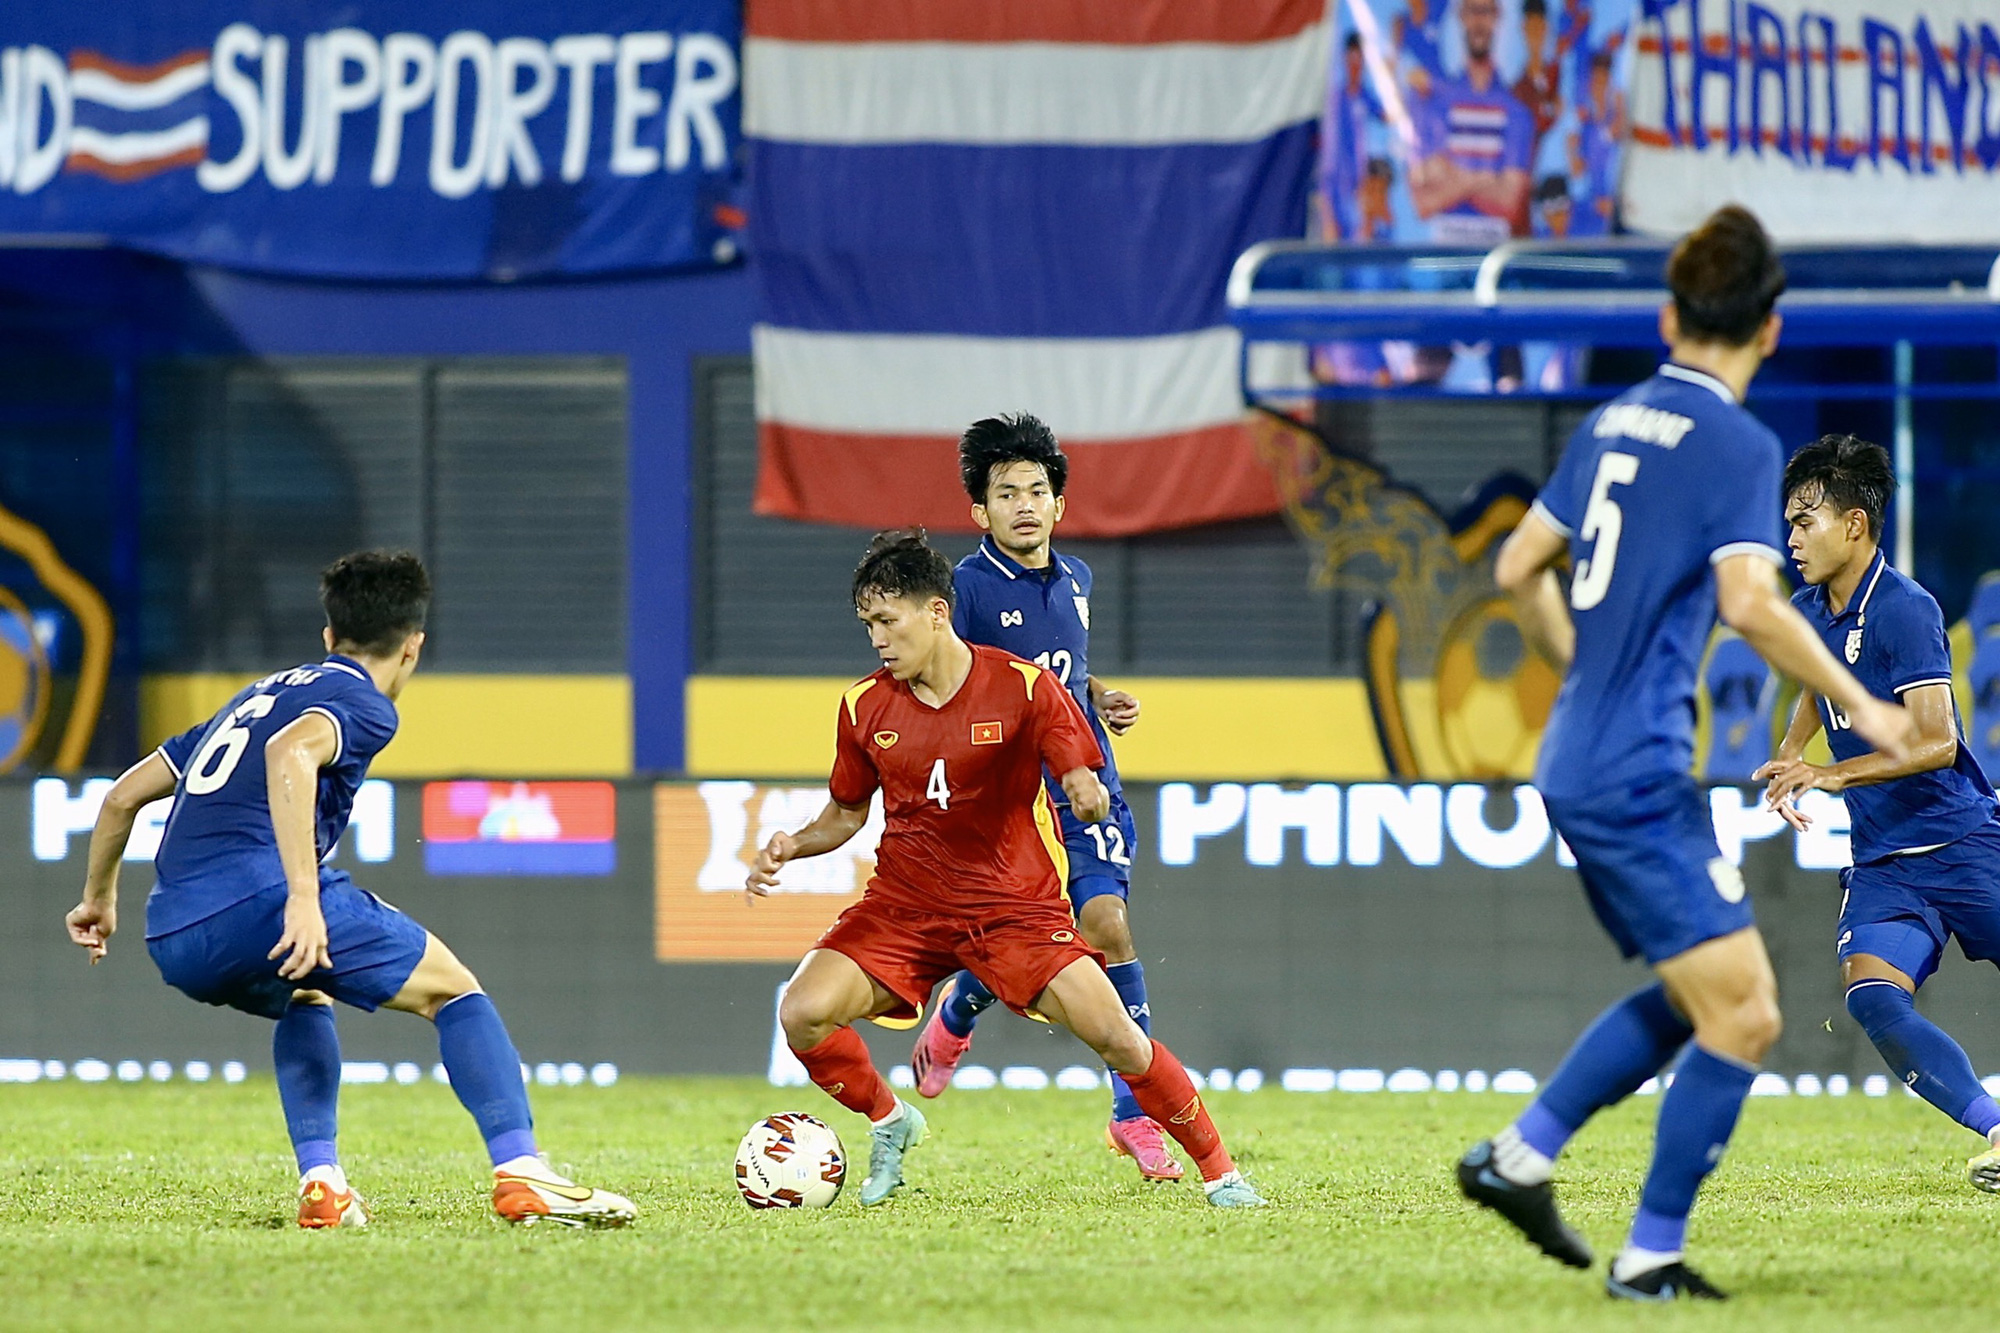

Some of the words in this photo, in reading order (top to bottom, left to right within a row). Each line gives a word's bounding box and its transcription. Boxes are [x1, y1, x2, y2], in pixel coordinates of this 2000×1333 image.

[197, 22, 737, 198] SUPPORTER
[1571, 451, 1640, 610] 5
[185, 694, 276, 795] 6
[926, 757, 951, 811] 4
[1084, 823, 1132, 867] 12
